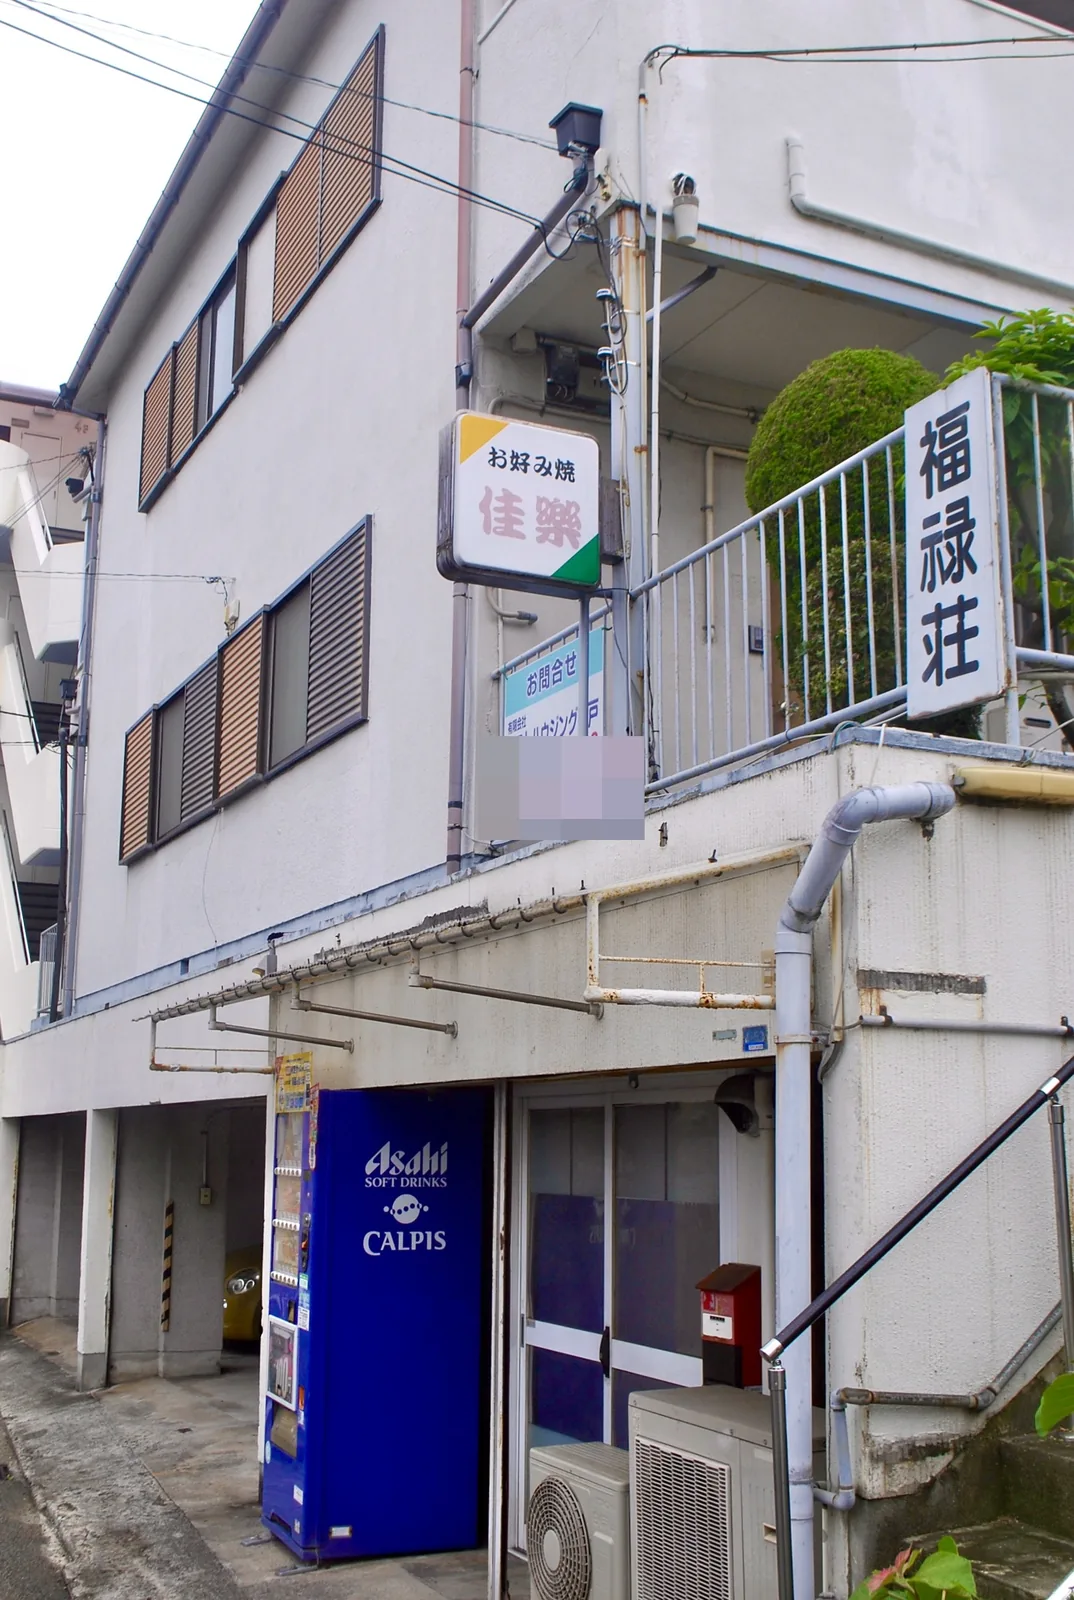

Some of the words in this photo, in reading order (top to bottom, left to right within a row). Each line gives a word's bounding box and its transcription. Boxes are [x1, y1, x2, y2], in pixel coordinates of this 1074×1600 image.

[487, 446, 576, 483] お好み焼
[919, 400, 980, 687] 福禄荘
[526, 652, 577, 696] お問合せ
[364, 1141, 448, 1176] Asahi
[364, 1177, 398, 1188] SOFT
[400, 1177, 448, 1188] DRINKS
[362, 1230, 447, 1256] CALPIS
